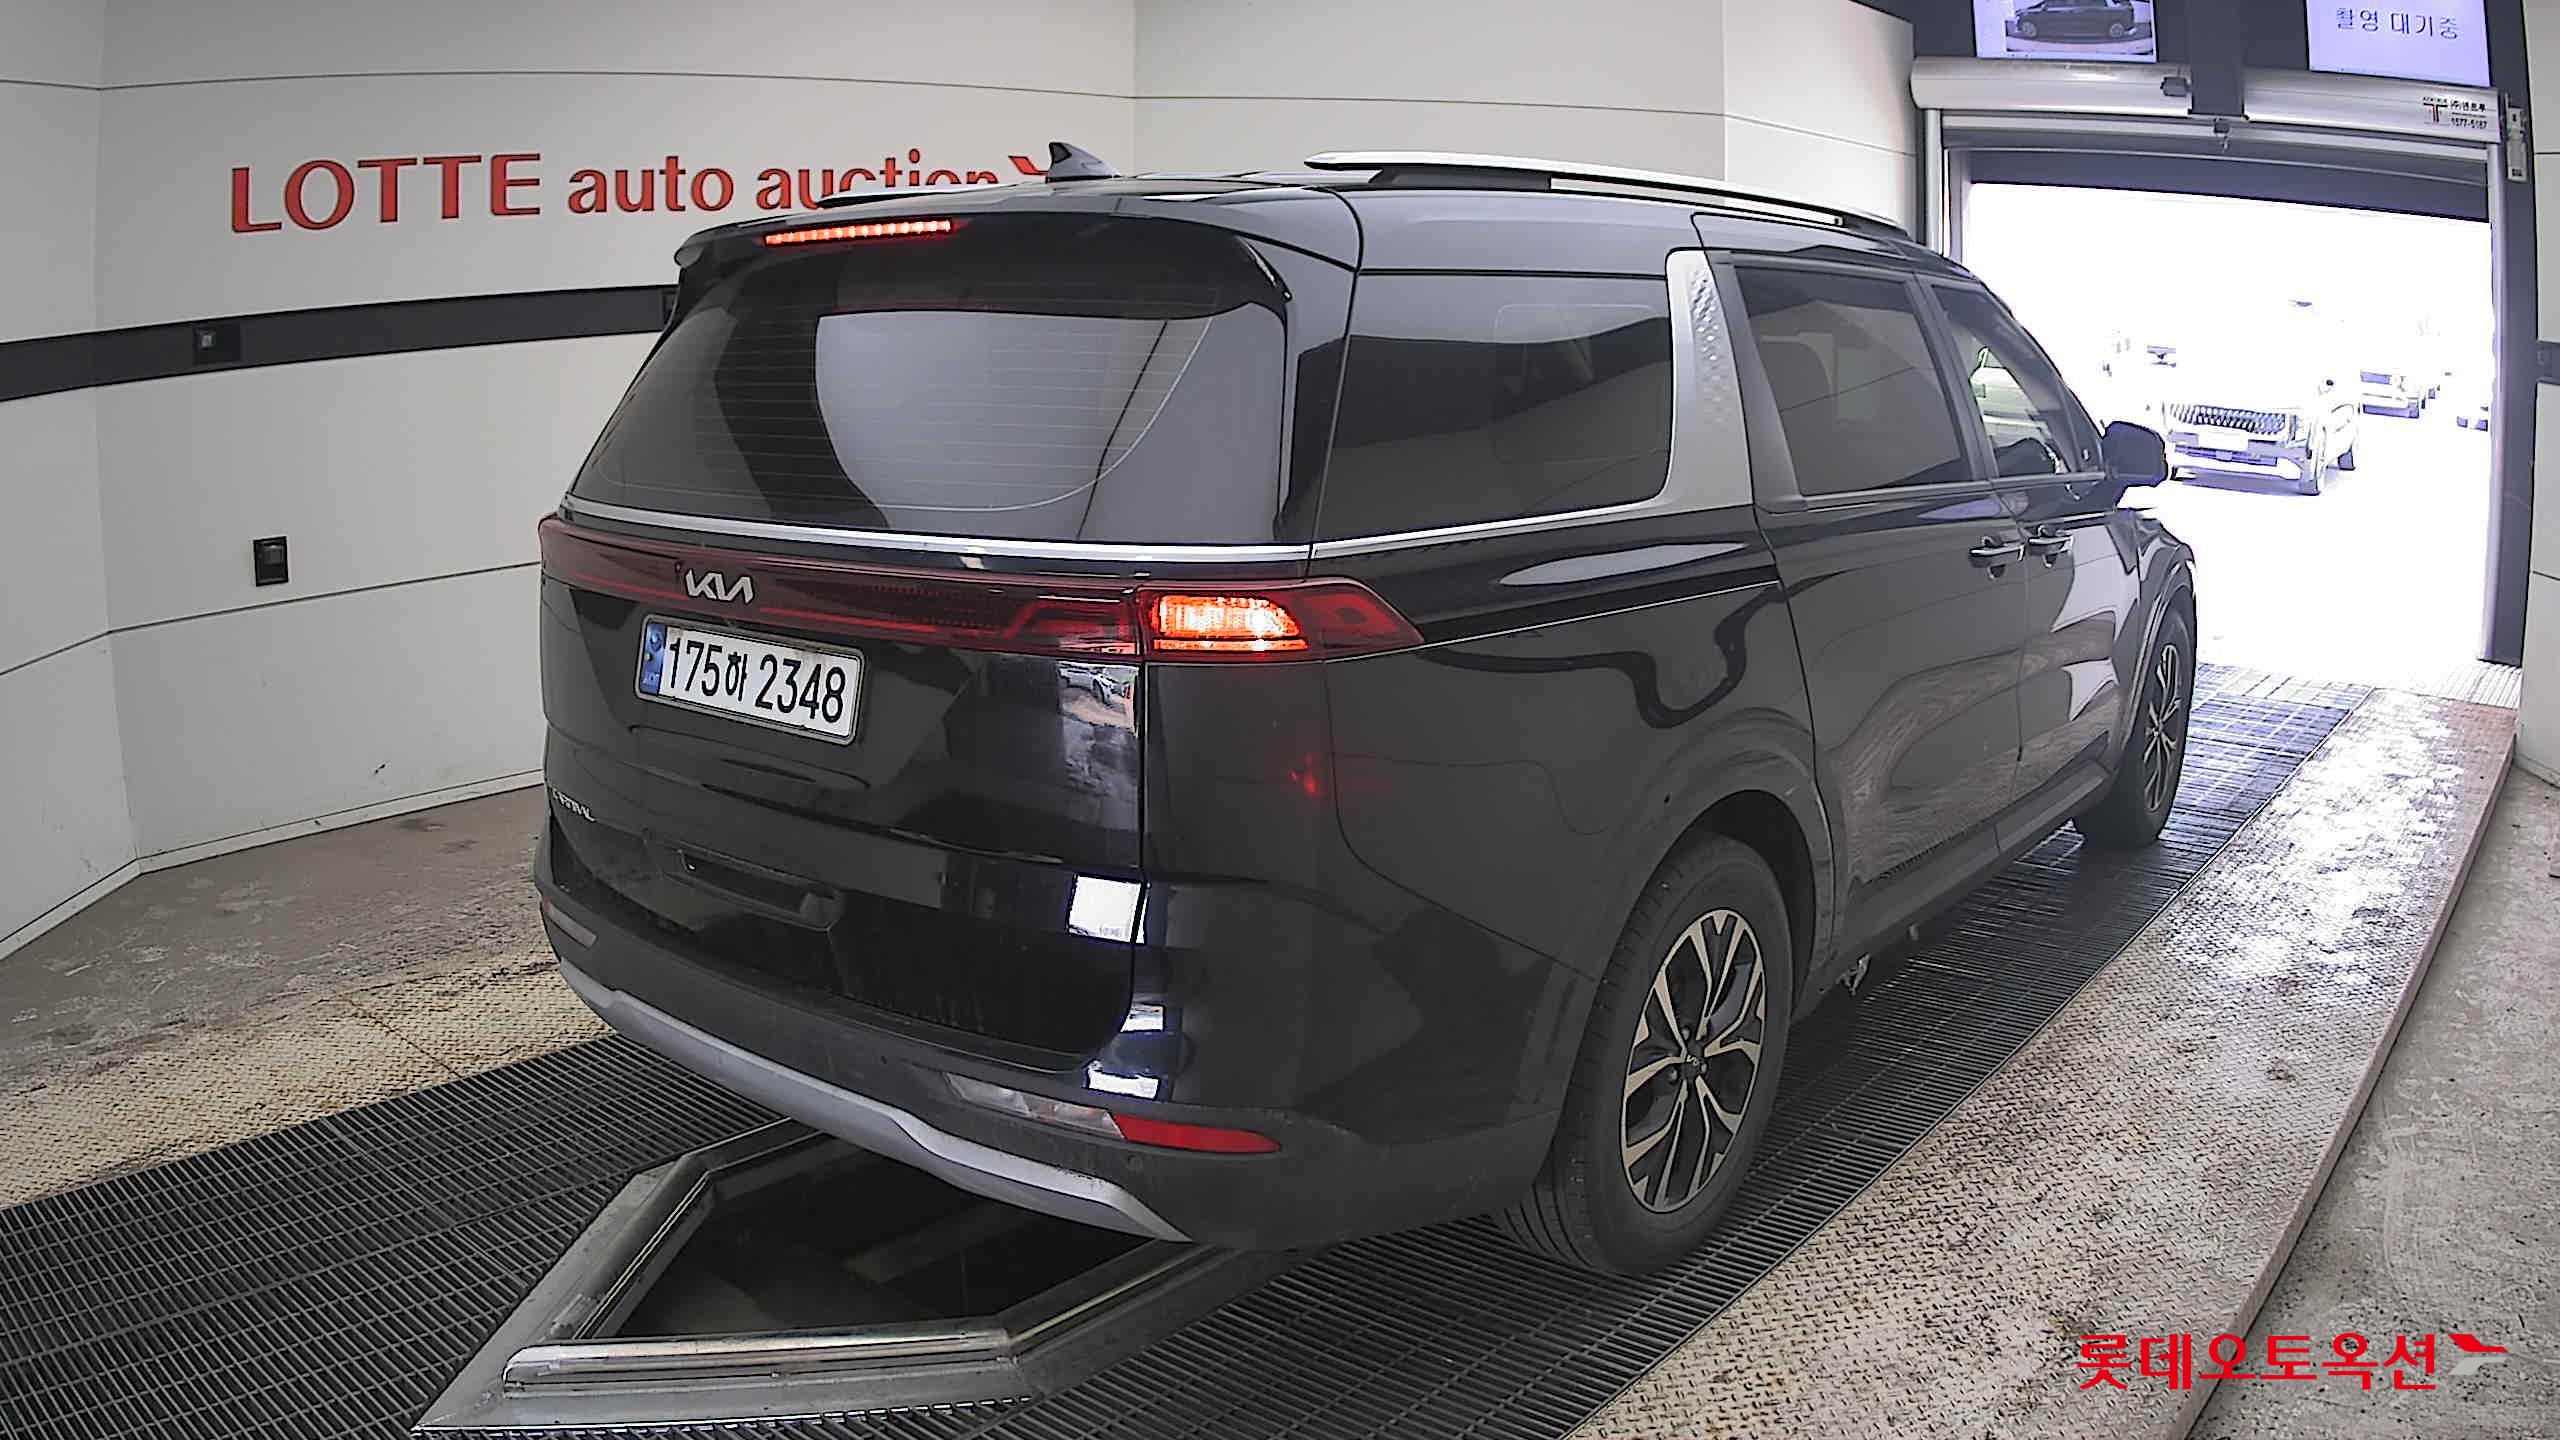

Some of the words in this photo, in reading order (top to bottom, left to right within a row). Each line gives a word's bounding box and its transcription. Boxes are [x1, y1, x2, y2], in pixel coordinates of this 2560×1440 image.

[2390, 12, 2458, 40] 대기중
[231, 153, 541, 233] LOTTE
[567, 155, 735, 214] auto
[684, 568, 755, 605] KIA
[668, 637, 749, 702] 175하
[755, 653, 847, 724] 2348
